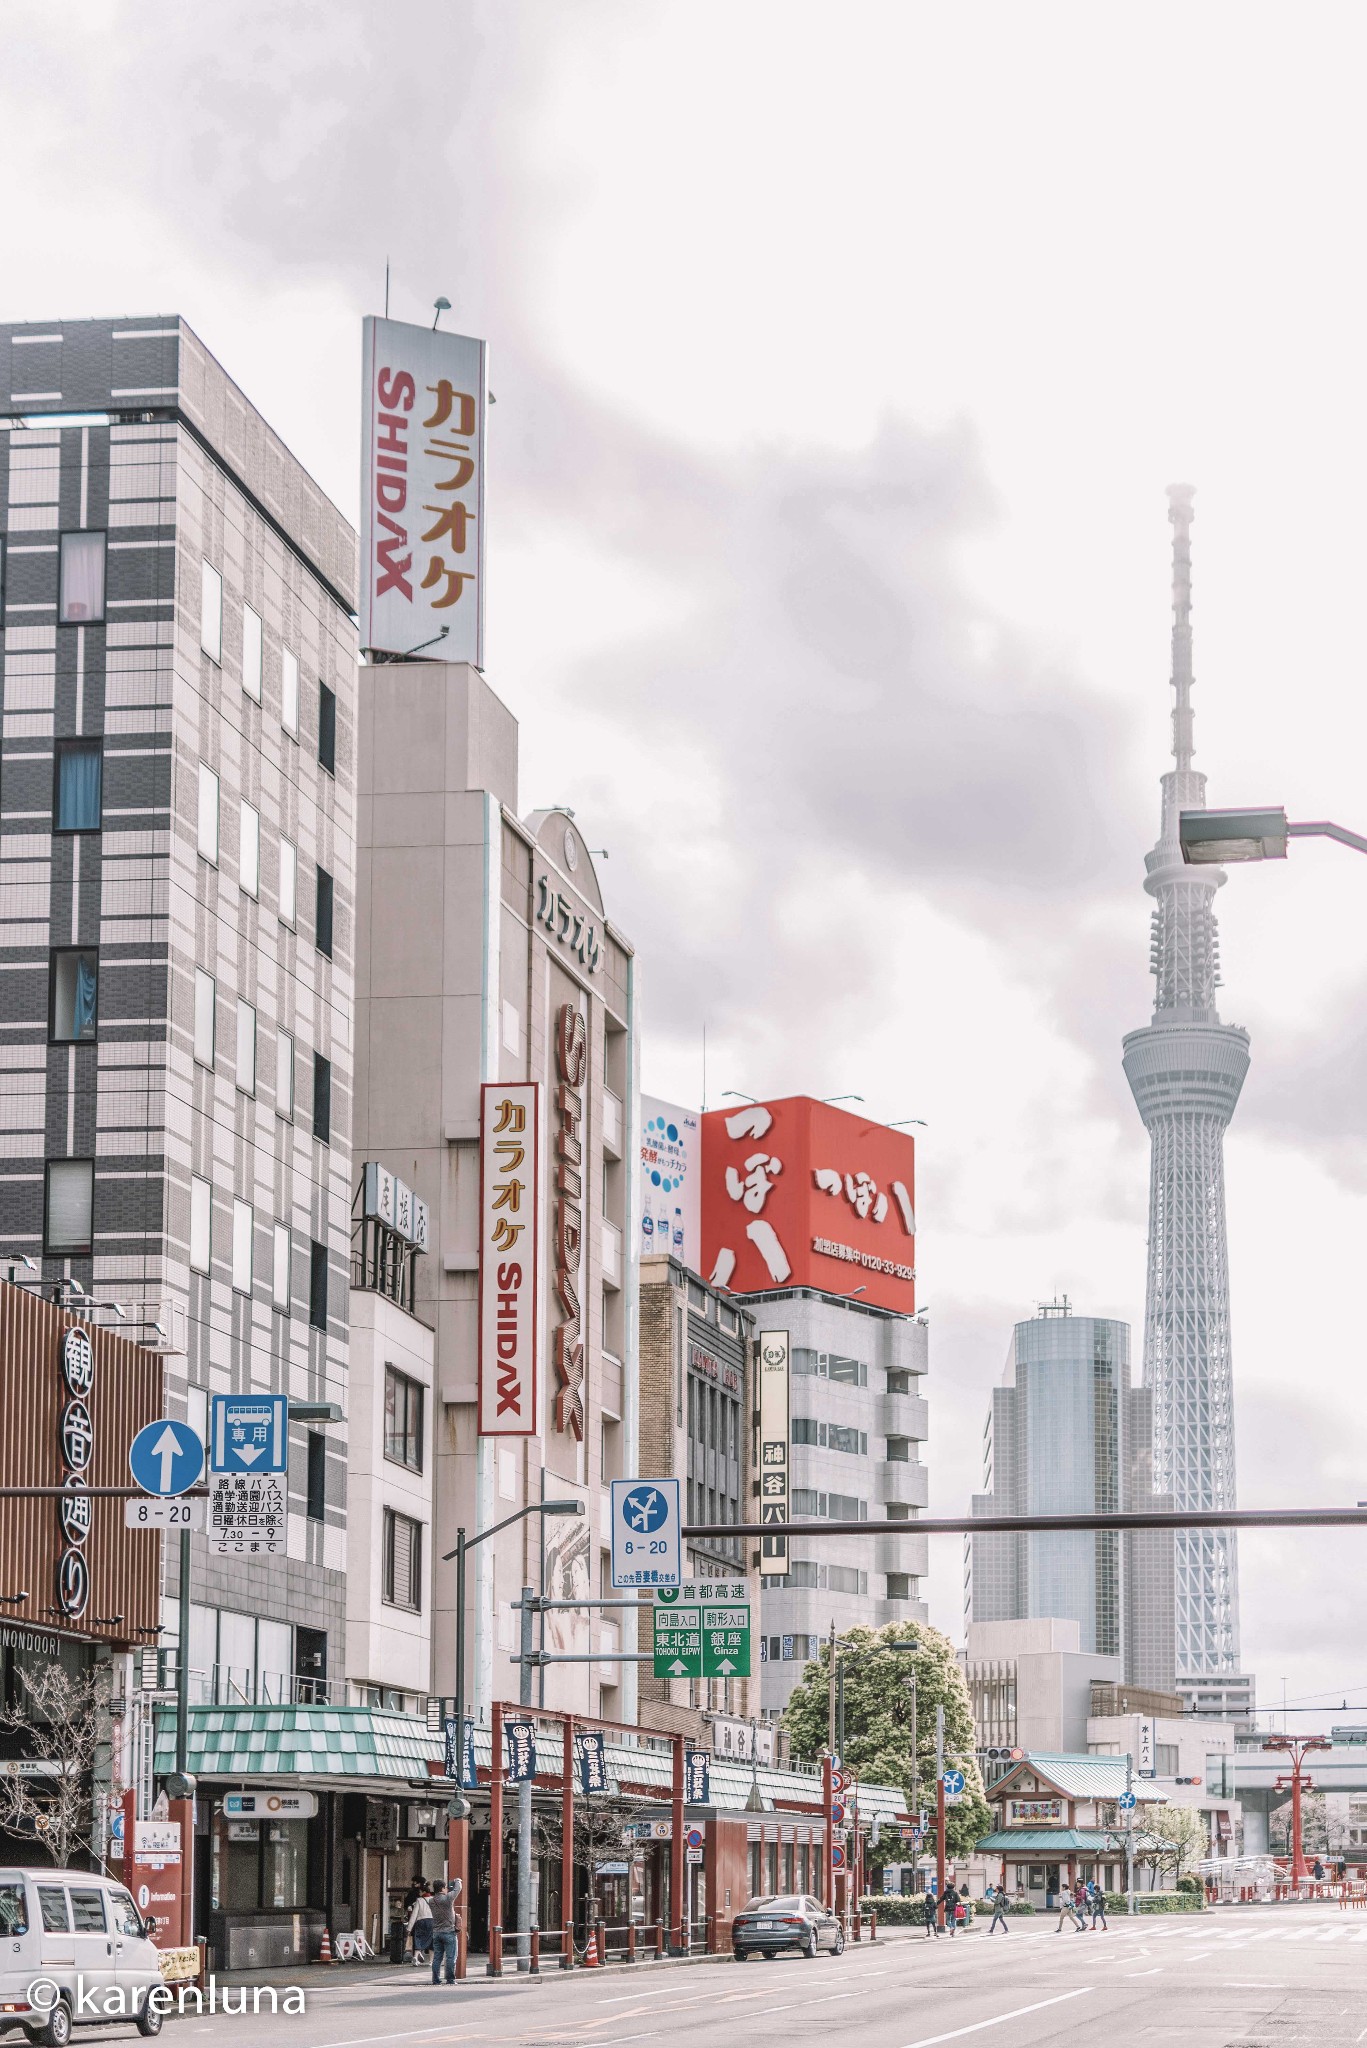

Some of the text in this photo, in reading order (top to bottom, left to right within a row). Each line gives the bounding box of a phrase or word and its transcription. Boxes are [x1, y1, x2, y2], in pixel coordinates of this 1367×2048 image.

[377, 366, 415, 604] SHIDAX
[420, 379, 476, 609] カラオケ
[537, 875, 605, 974] カラオケ
[491, 1099, 525, 1252] カラオケ
[709, 1106, 792, 1288] つぼ八
[812, 1168, 916, 1236] つぼ八
[557, 1002, 587, 1442] SHIDAX
[496, 1261, 523, 1418] SHIDAX
[231, 1427, 267, 1442] 専用
[62, 1333, 92, 1608] 観音通り
[218, 1479, 278, 1490] 路線バス
[212, 1501, 284, 1513] 通勤送迎バス
[763, 1443, 785, 1557] 神谷バー
[138, 1505, 191, 1522] 8-20
[218, 1542, 277, 1552] ここまで
[625, 1541, 667, 1555] 8-20
[617, 1570, 676, 1584] この先吾妻橋交差点
[683, 1584, 745, 1599] 首都高速
[658, 1613, 697, 1627] 向島入口
[706, 1612, 745, 1626] 駒形入口
[0, 1628, 60, 1656] NONDOORI
[656, 1632, 700, 1647] 東北道
[710, 1631, 742, 1646] 銀座
[655, 1647, 679, 1656] TOHOKU
[713, 1646, 739, 1655] Ginza
[1141, 1725, 1149, 1764] 水上バス
[150, 1892, 176, 1902] Information
[13, 1942, 21, 1953] 3
